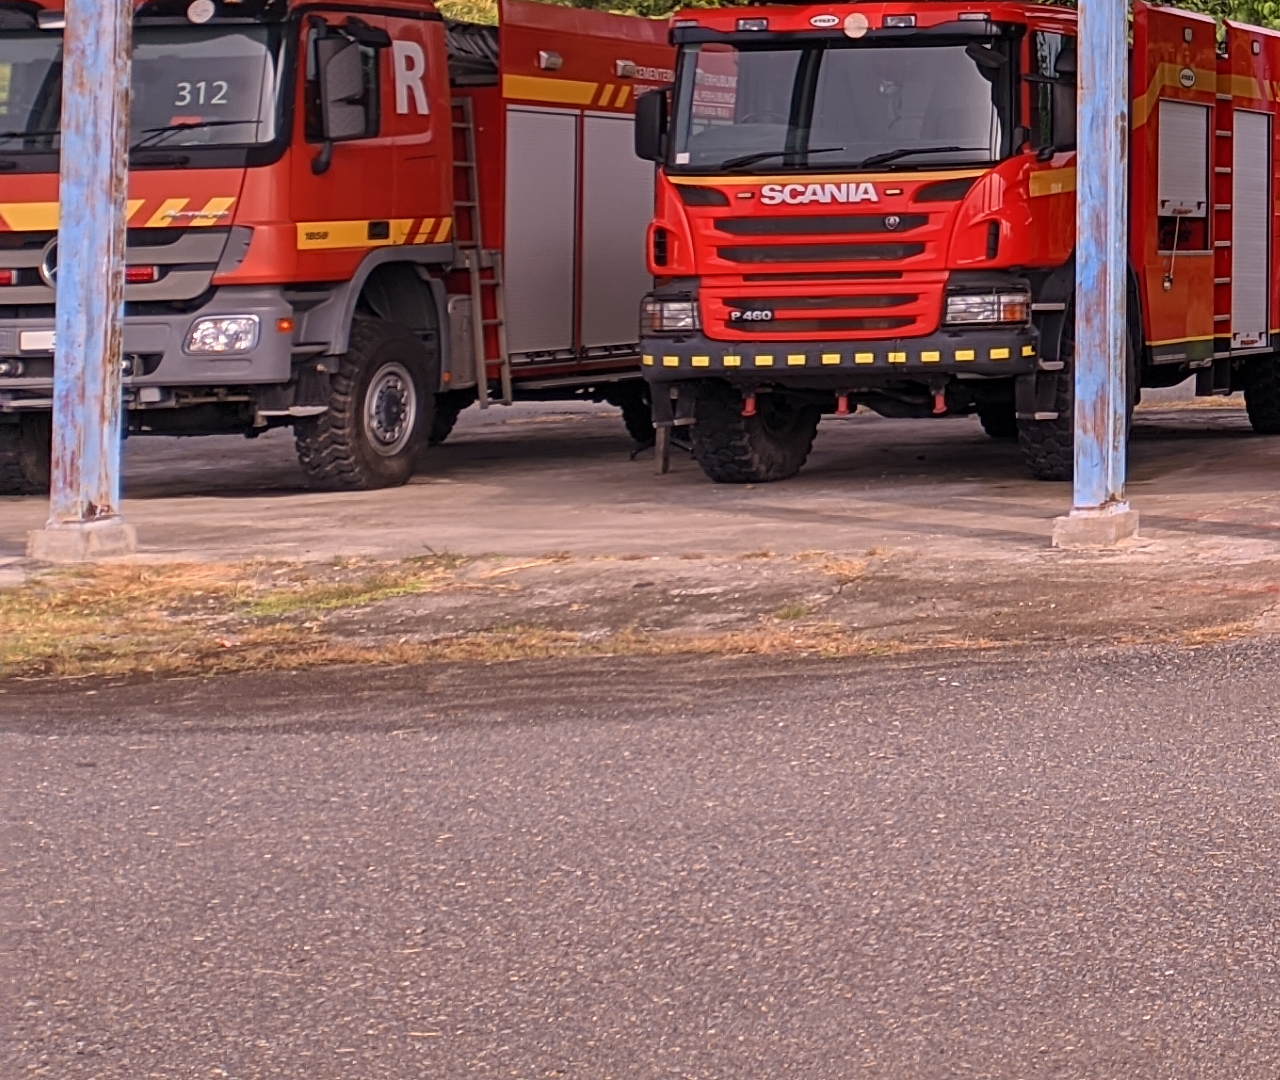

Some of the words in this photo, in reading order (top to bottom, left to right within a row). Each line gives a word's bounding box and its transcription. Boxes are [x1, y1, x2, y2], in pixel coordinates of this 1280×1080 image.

[392, 40, 430, 115] R
[174, 80, 228, 106] 312
[760, 182, 879, 205] SCANIA
[731, 311, 741, 320] P
[742, 310, 772, 320] 460
